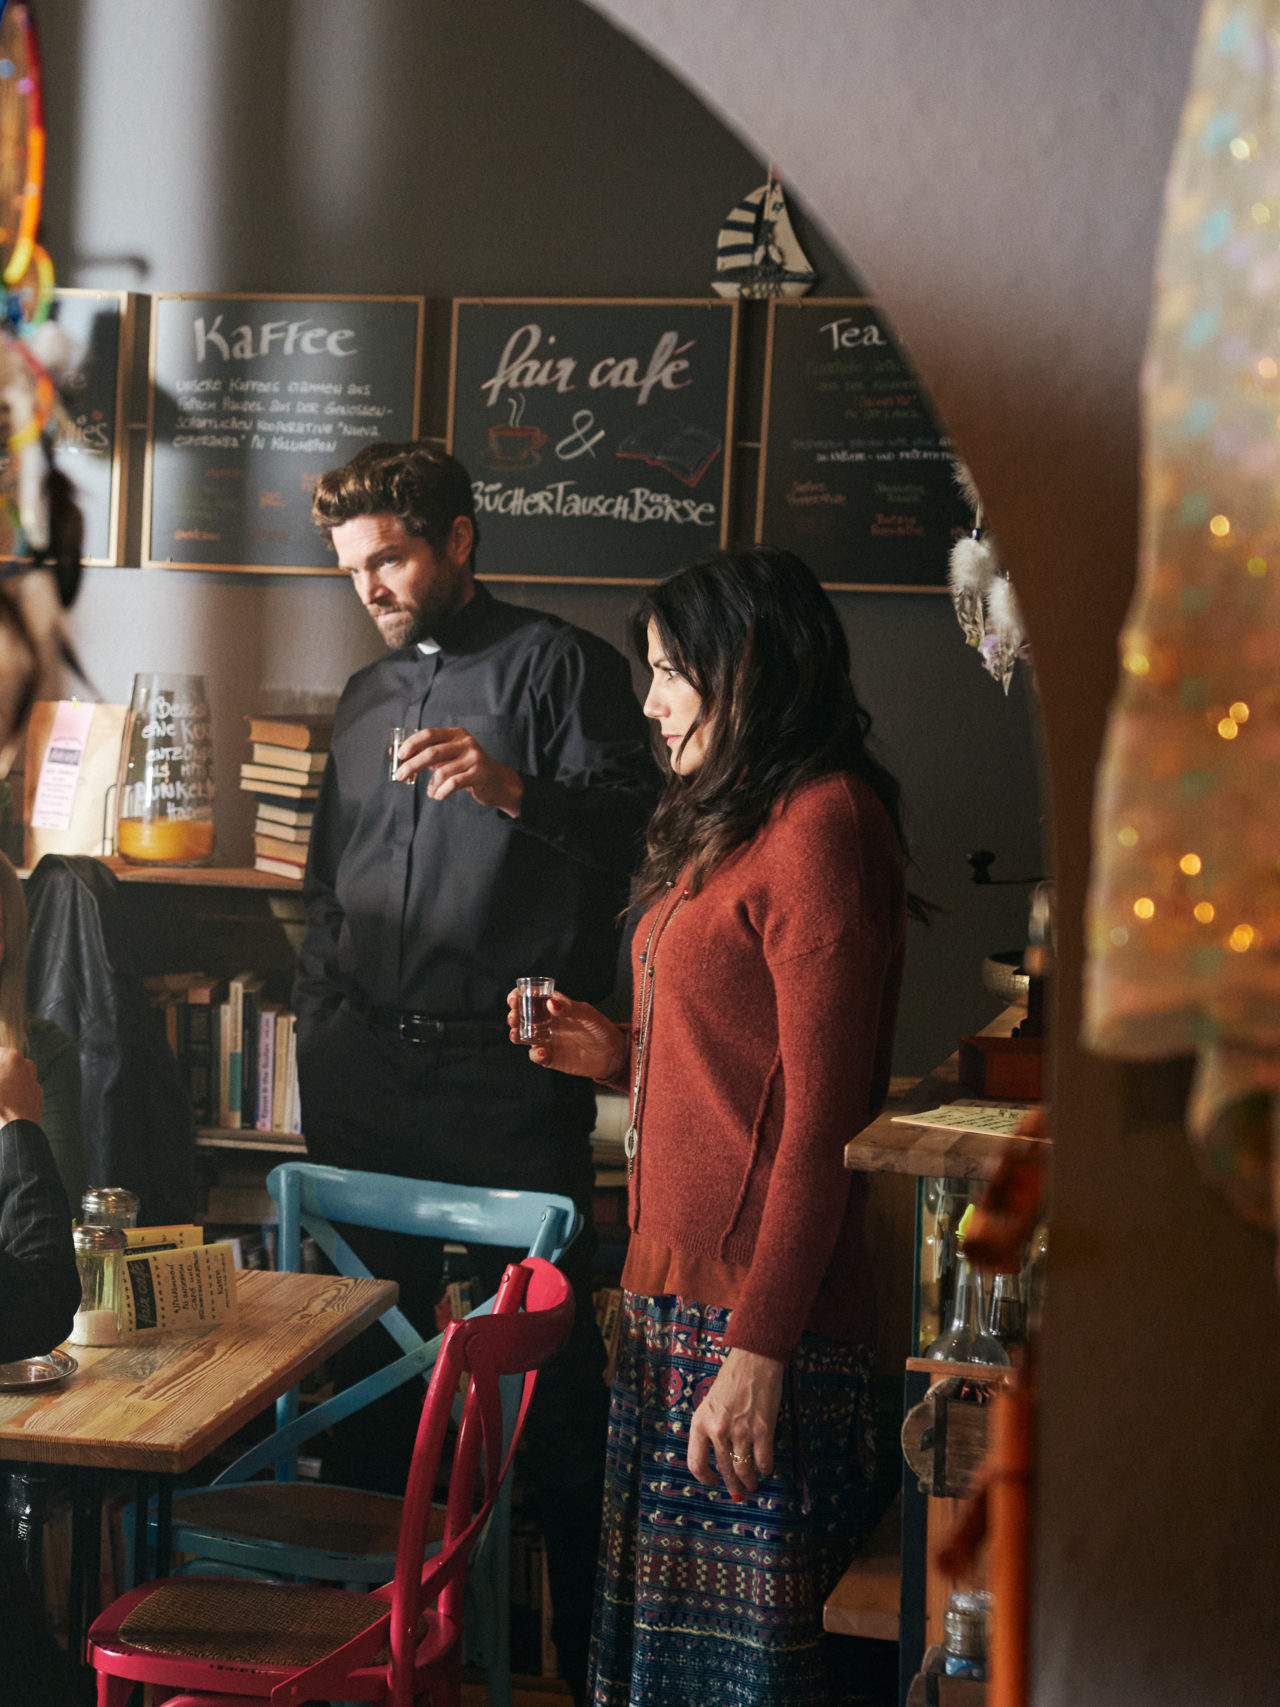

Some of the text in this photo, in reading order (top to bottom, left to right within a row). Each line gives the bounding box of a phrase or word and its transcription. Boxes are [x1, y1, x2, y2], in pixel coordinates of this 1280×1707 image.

[819, 317, 888, 351] Tea
[481, 323, 696, 408] fair café
[555, 409, 605, 461] &
